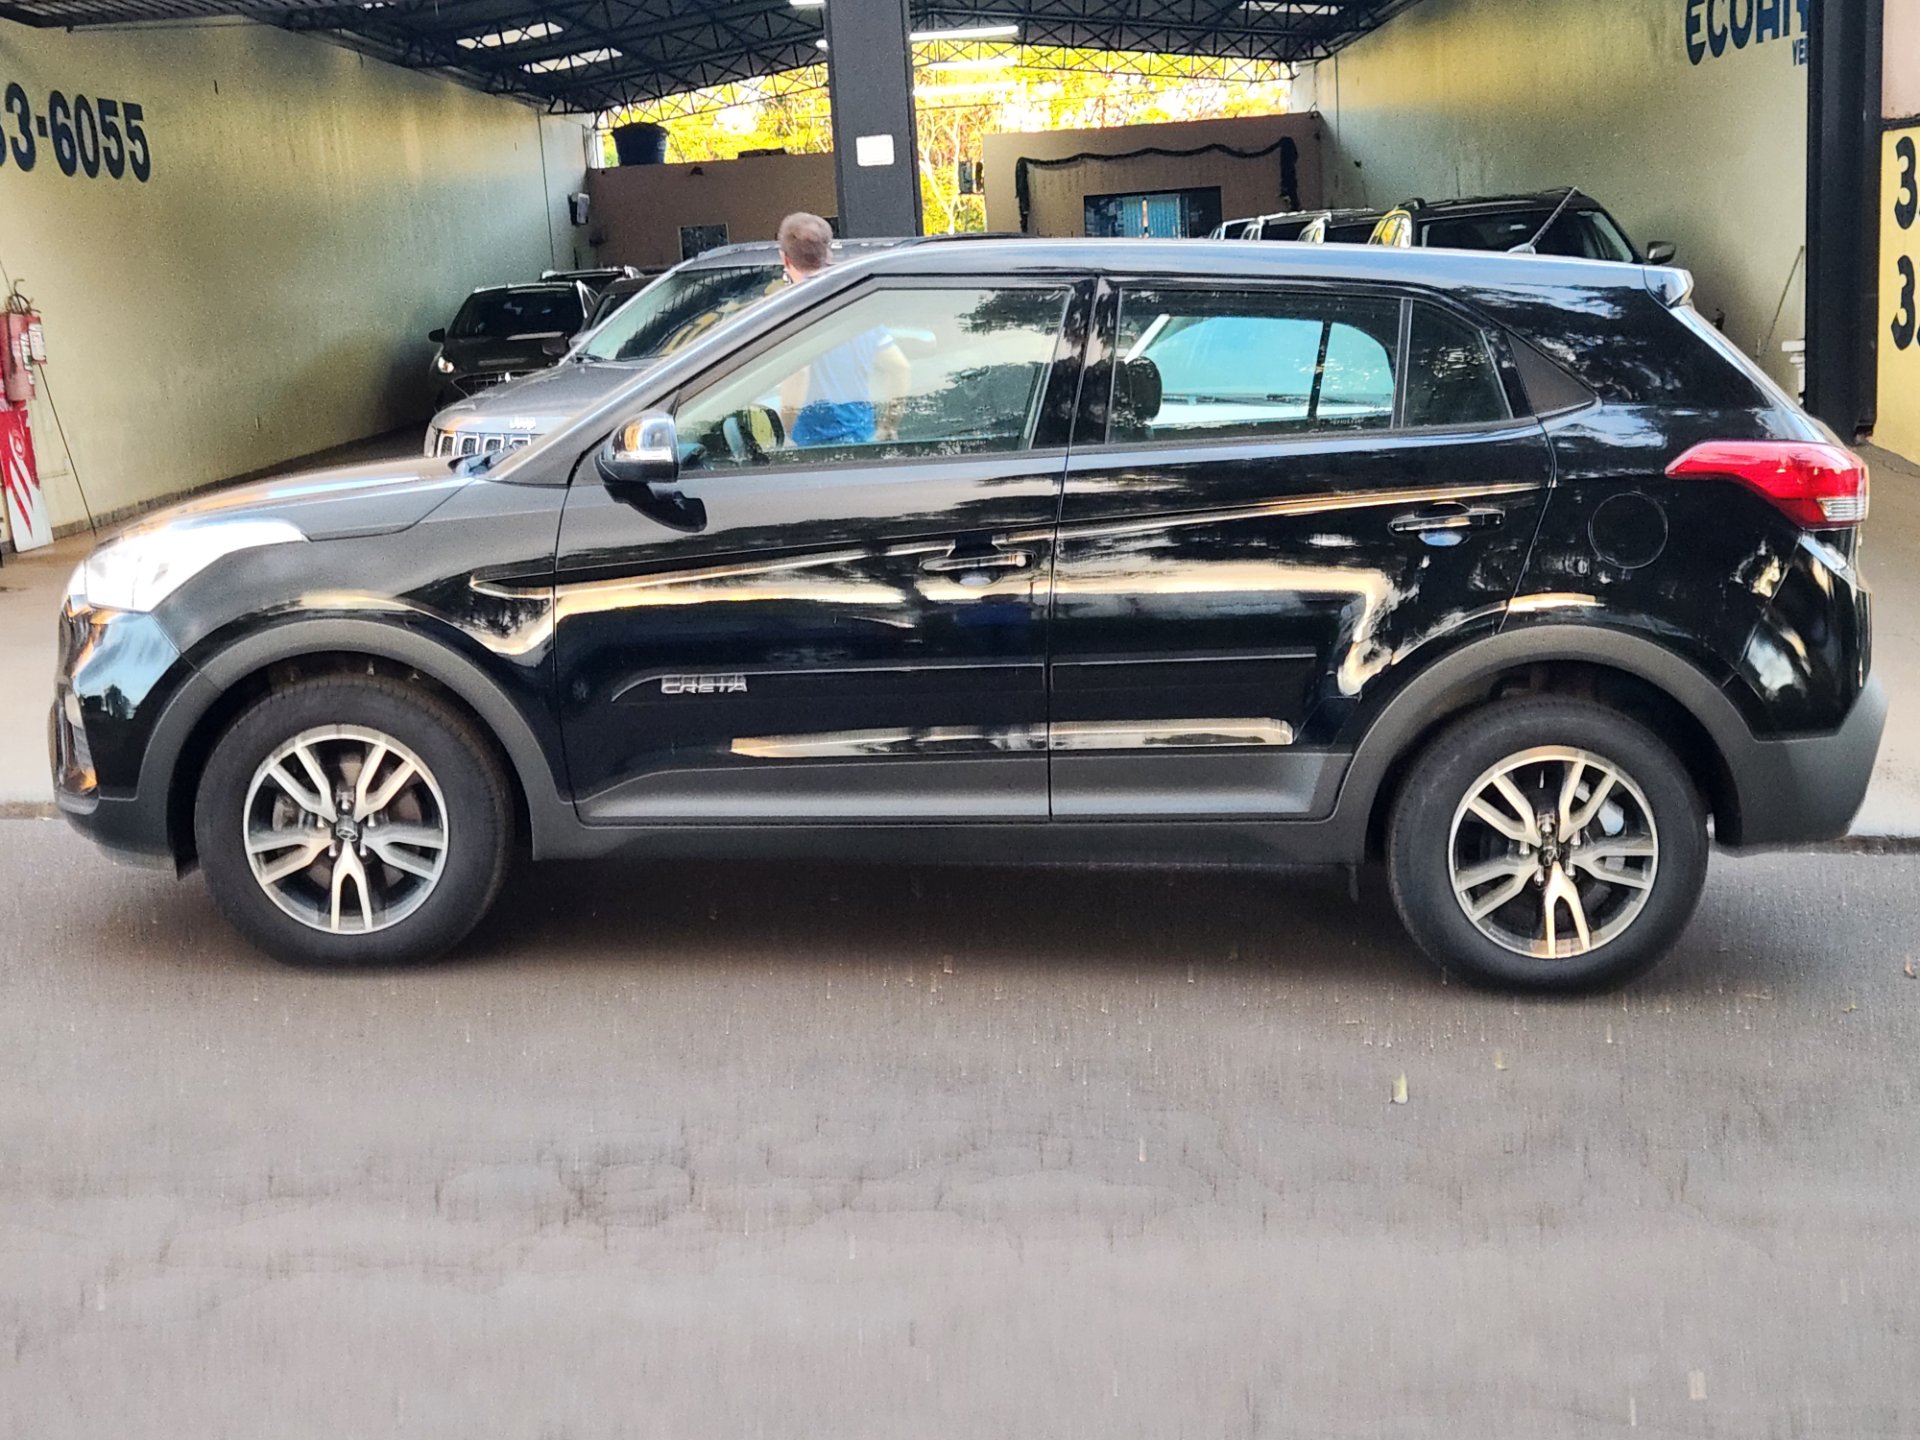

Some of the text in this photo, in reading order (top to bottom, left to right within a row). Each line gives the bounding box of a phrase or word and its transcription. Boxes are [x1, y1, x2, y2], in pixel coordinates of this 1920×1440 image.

[0, 82, 151, 182] 3-6055
[1894, 136, 1920, 229] 3
[1891, 255, 1920, 350] 3
[661, 674, 748, 694] CRETA
